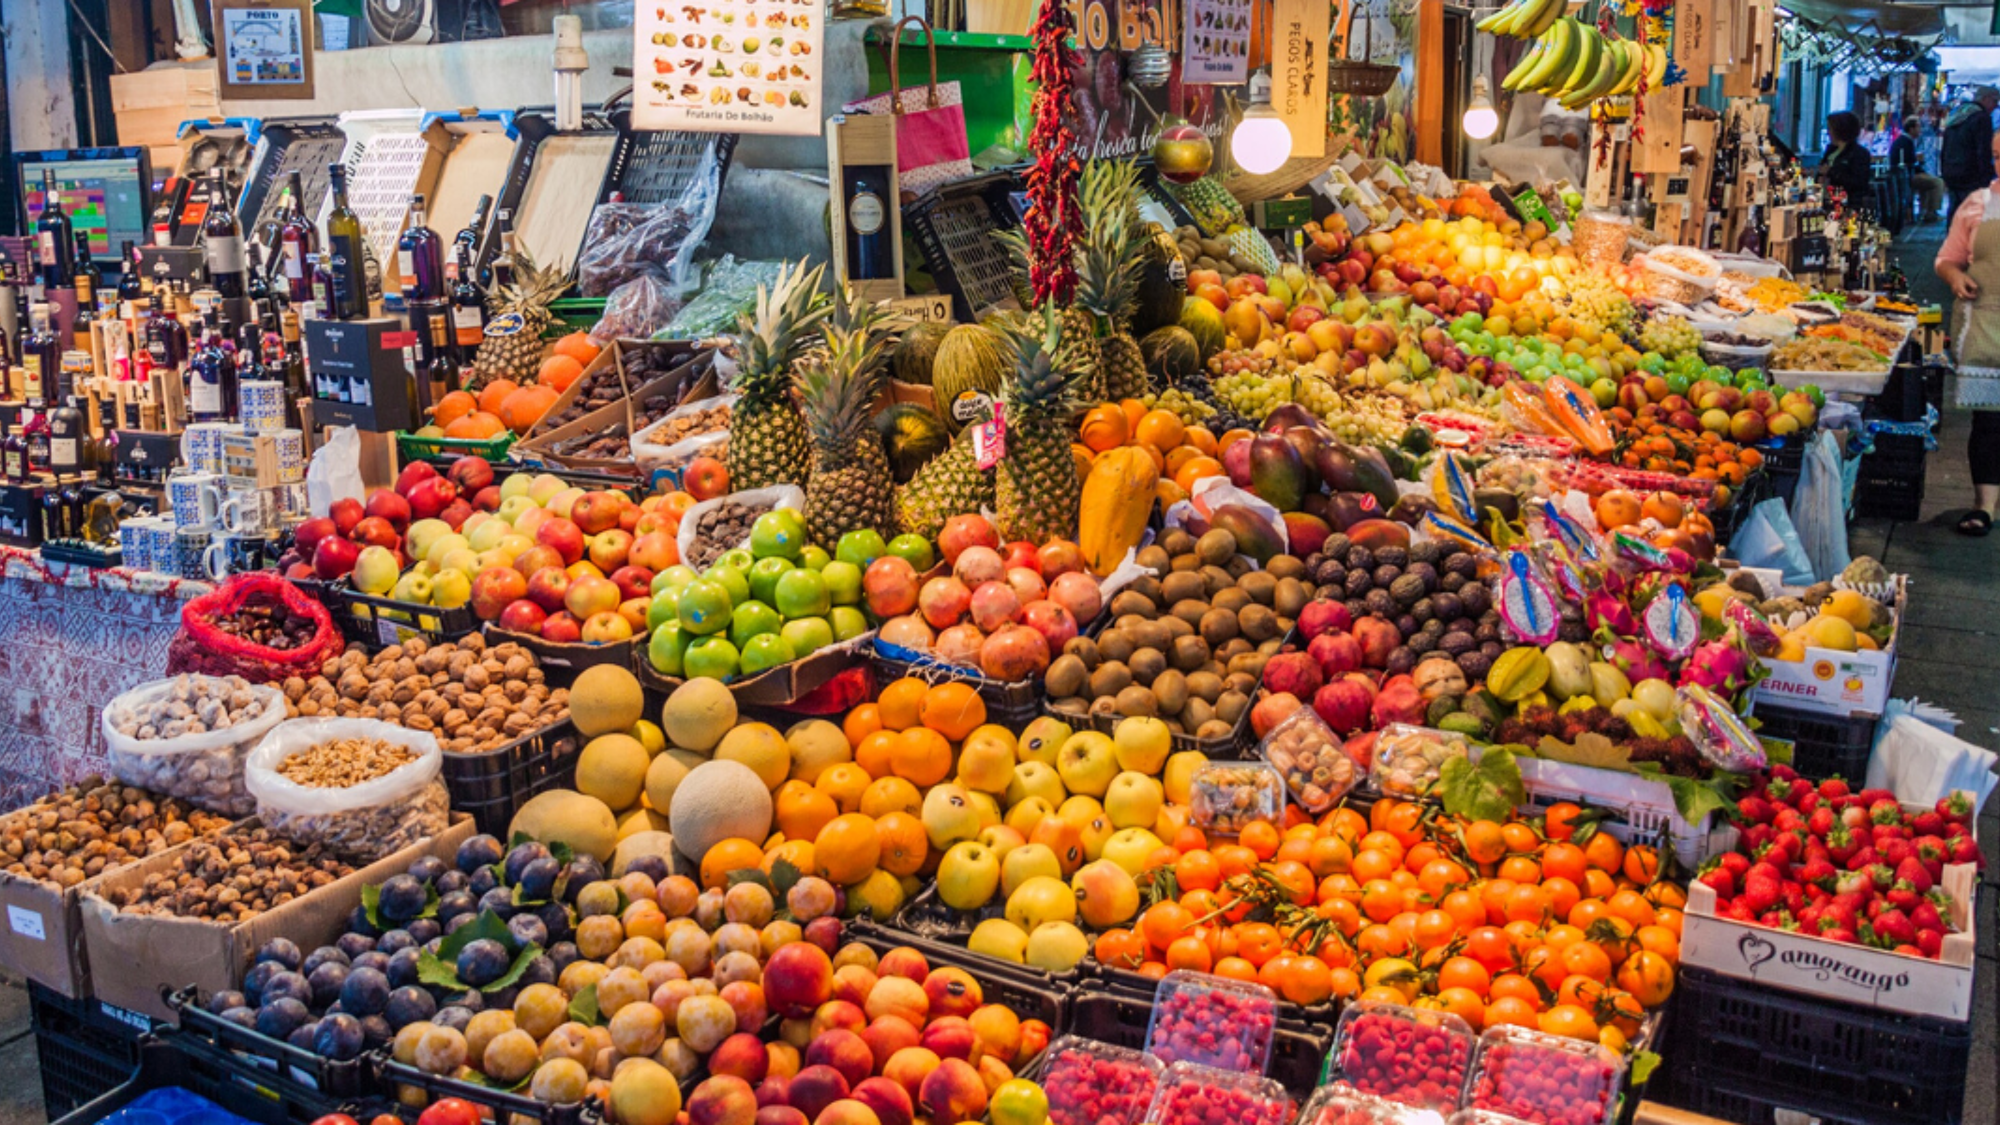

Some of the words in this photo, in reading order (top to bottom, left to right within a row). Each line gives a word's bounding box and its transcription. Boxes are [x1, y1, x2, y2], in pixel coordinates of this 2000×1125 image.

[246, 11, 279, 19] PORTO
[1288, 22, 1301, 64] PEGOS
[1286, 68, 1299, 116] CLAROS
[685, 109, 723, 120] Frutaria
[725, 112, 738, 120] Do
[740, 112, 774, 122] Bolhão
[1760, 678, 1818, 696] ERNER
